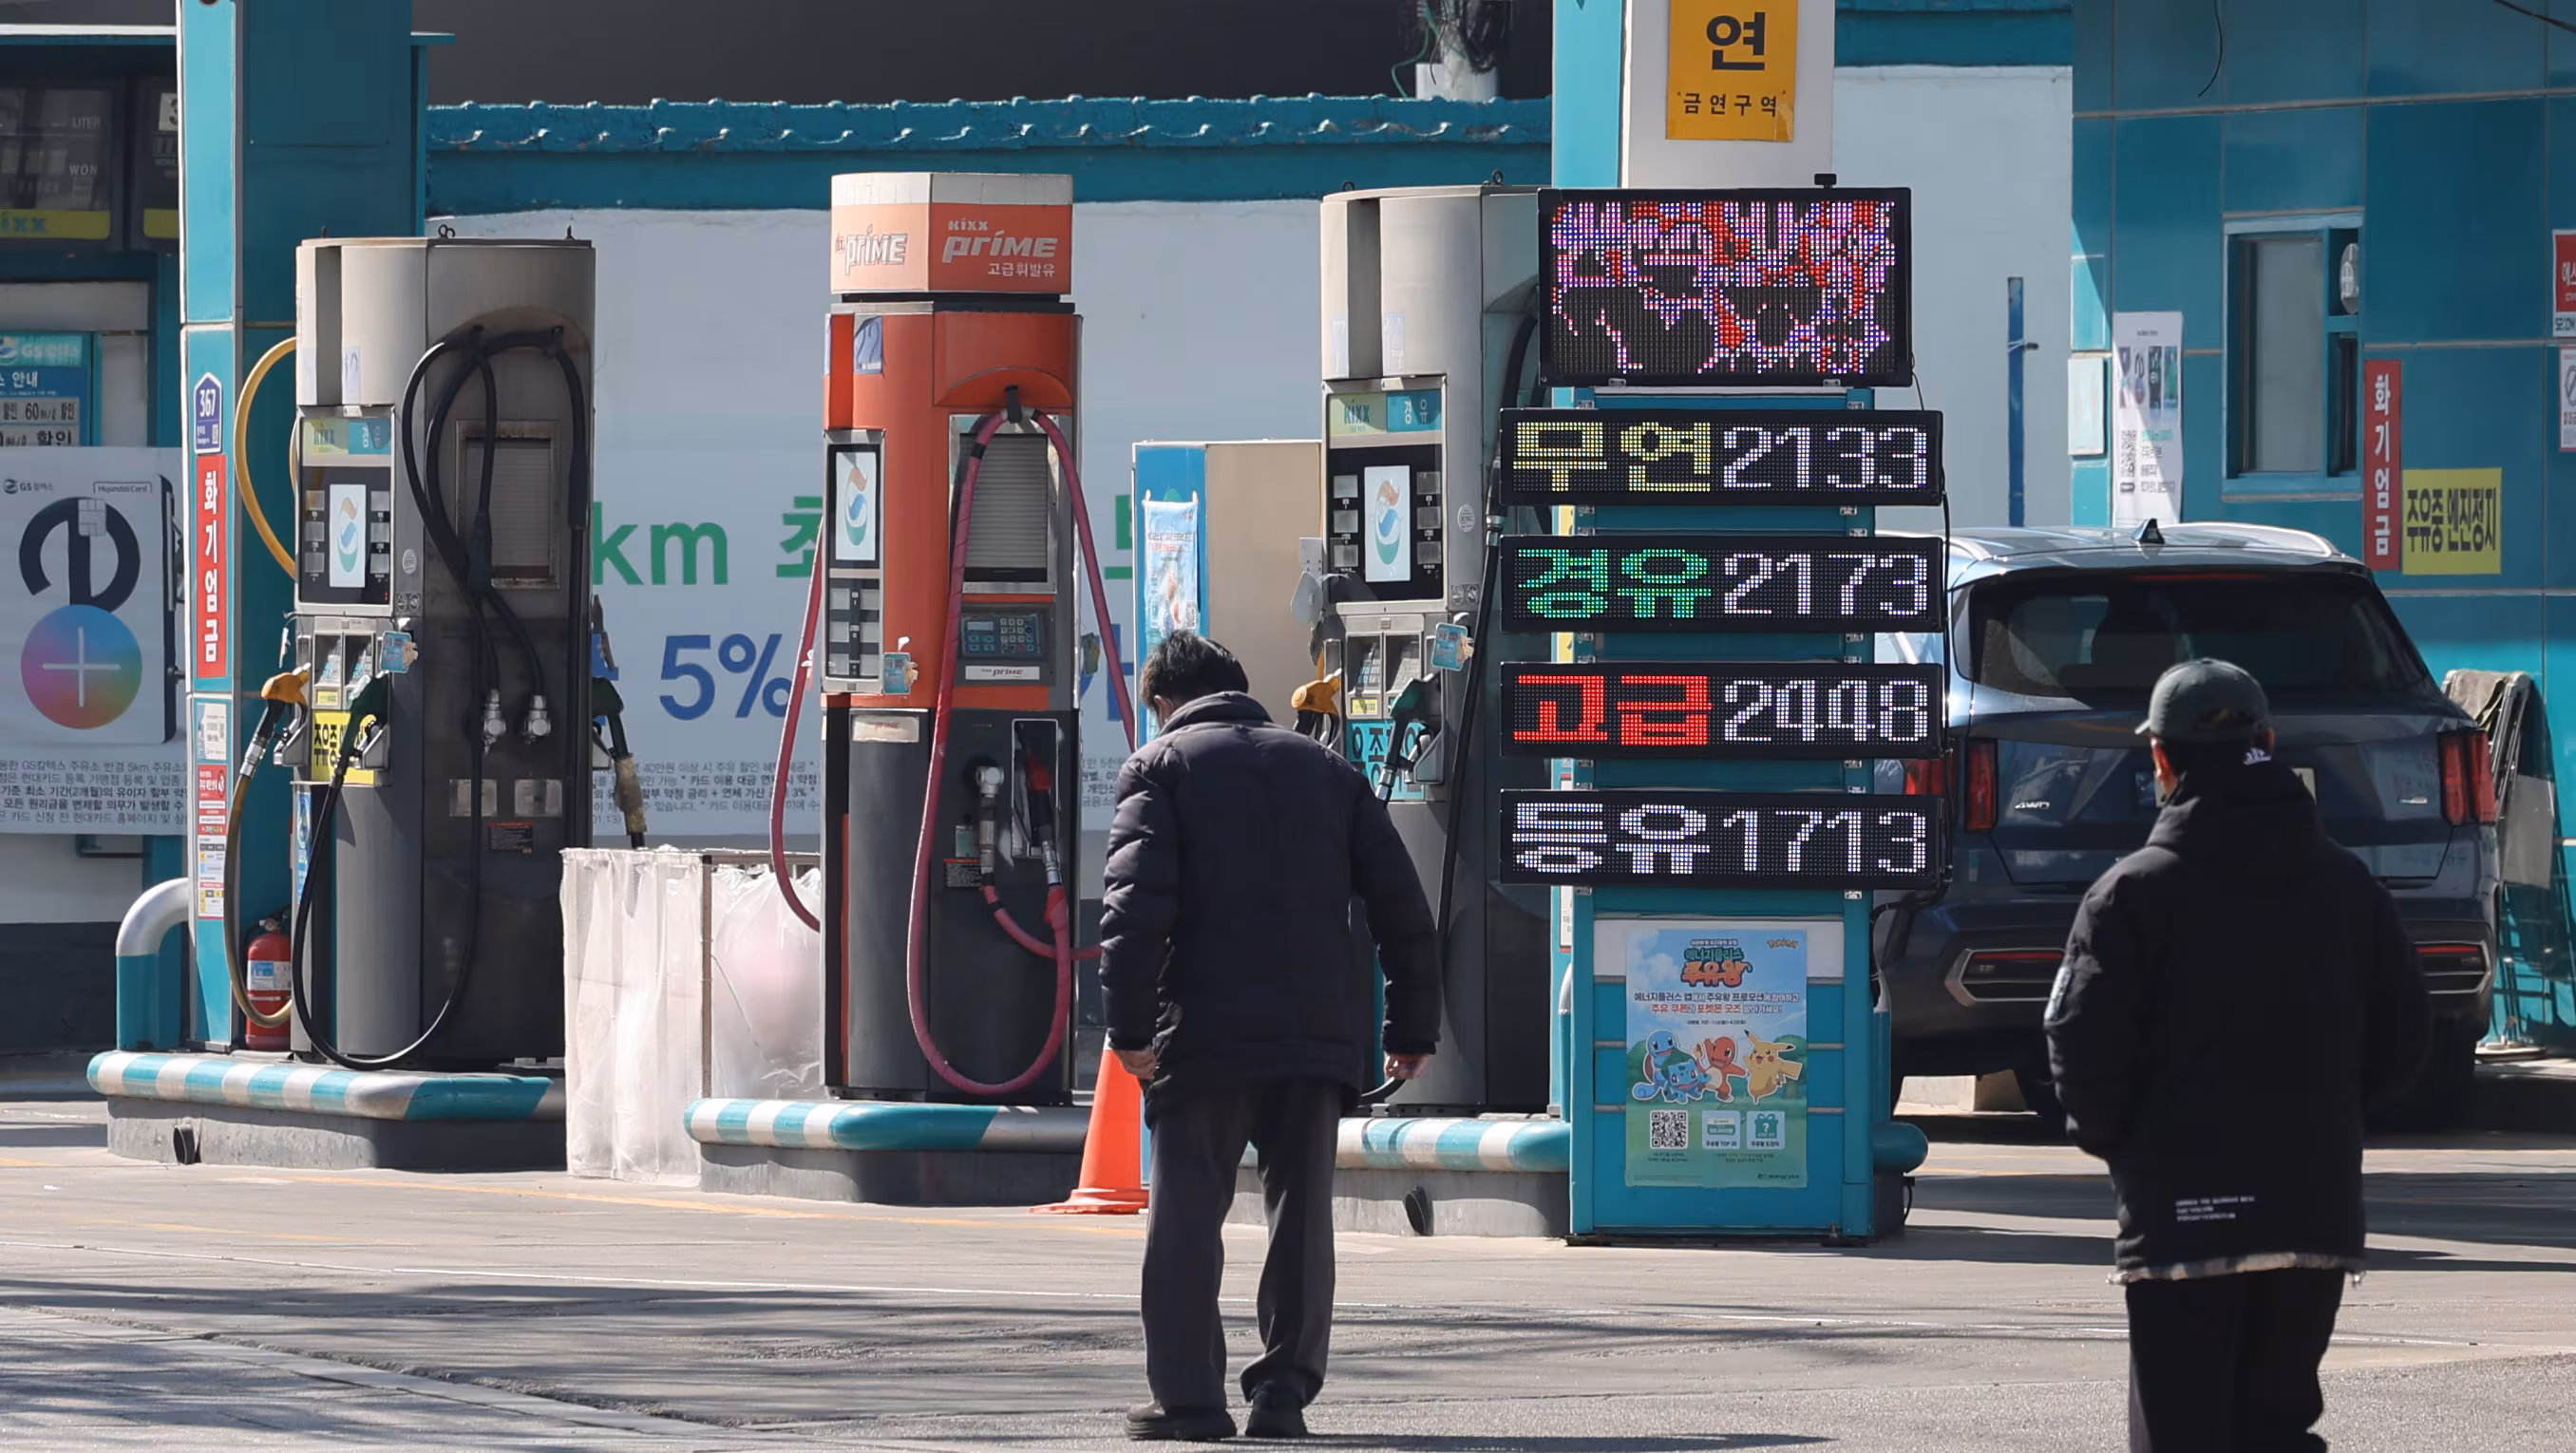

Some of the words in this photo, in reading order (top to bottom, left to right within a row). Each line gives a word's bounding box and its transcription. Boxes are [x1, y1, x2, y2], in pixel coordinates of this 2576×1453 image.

[1683, 92, 1777, 117] 금연구역
[988, 262, 1056, 278] 고급휘발유
[12, 371, 38, 387] 안내
[199, 388, 218, 418] 367
[19, 482, 32, 492] GS
[1513, 422, 1711, 492] 무연
[1723, 427, 1927, 488] 2133
[2374, 373, 2391, 557] 화기엄금
[204, 470, 218, 663] 화기엄금
[1518, 548, 1712, 618] 경유
[1723, 554, 1927, 615] 2173
[659, 633, 794, 721] 5%
[1513, 675, 1713, 745] 고급
[1724, 680, 1928, 742] 2448
[127, 763, 149, 773] 5km
[1512, 802, 1711, 875] 등유
[1723, 810, 1926, 873] 1713
